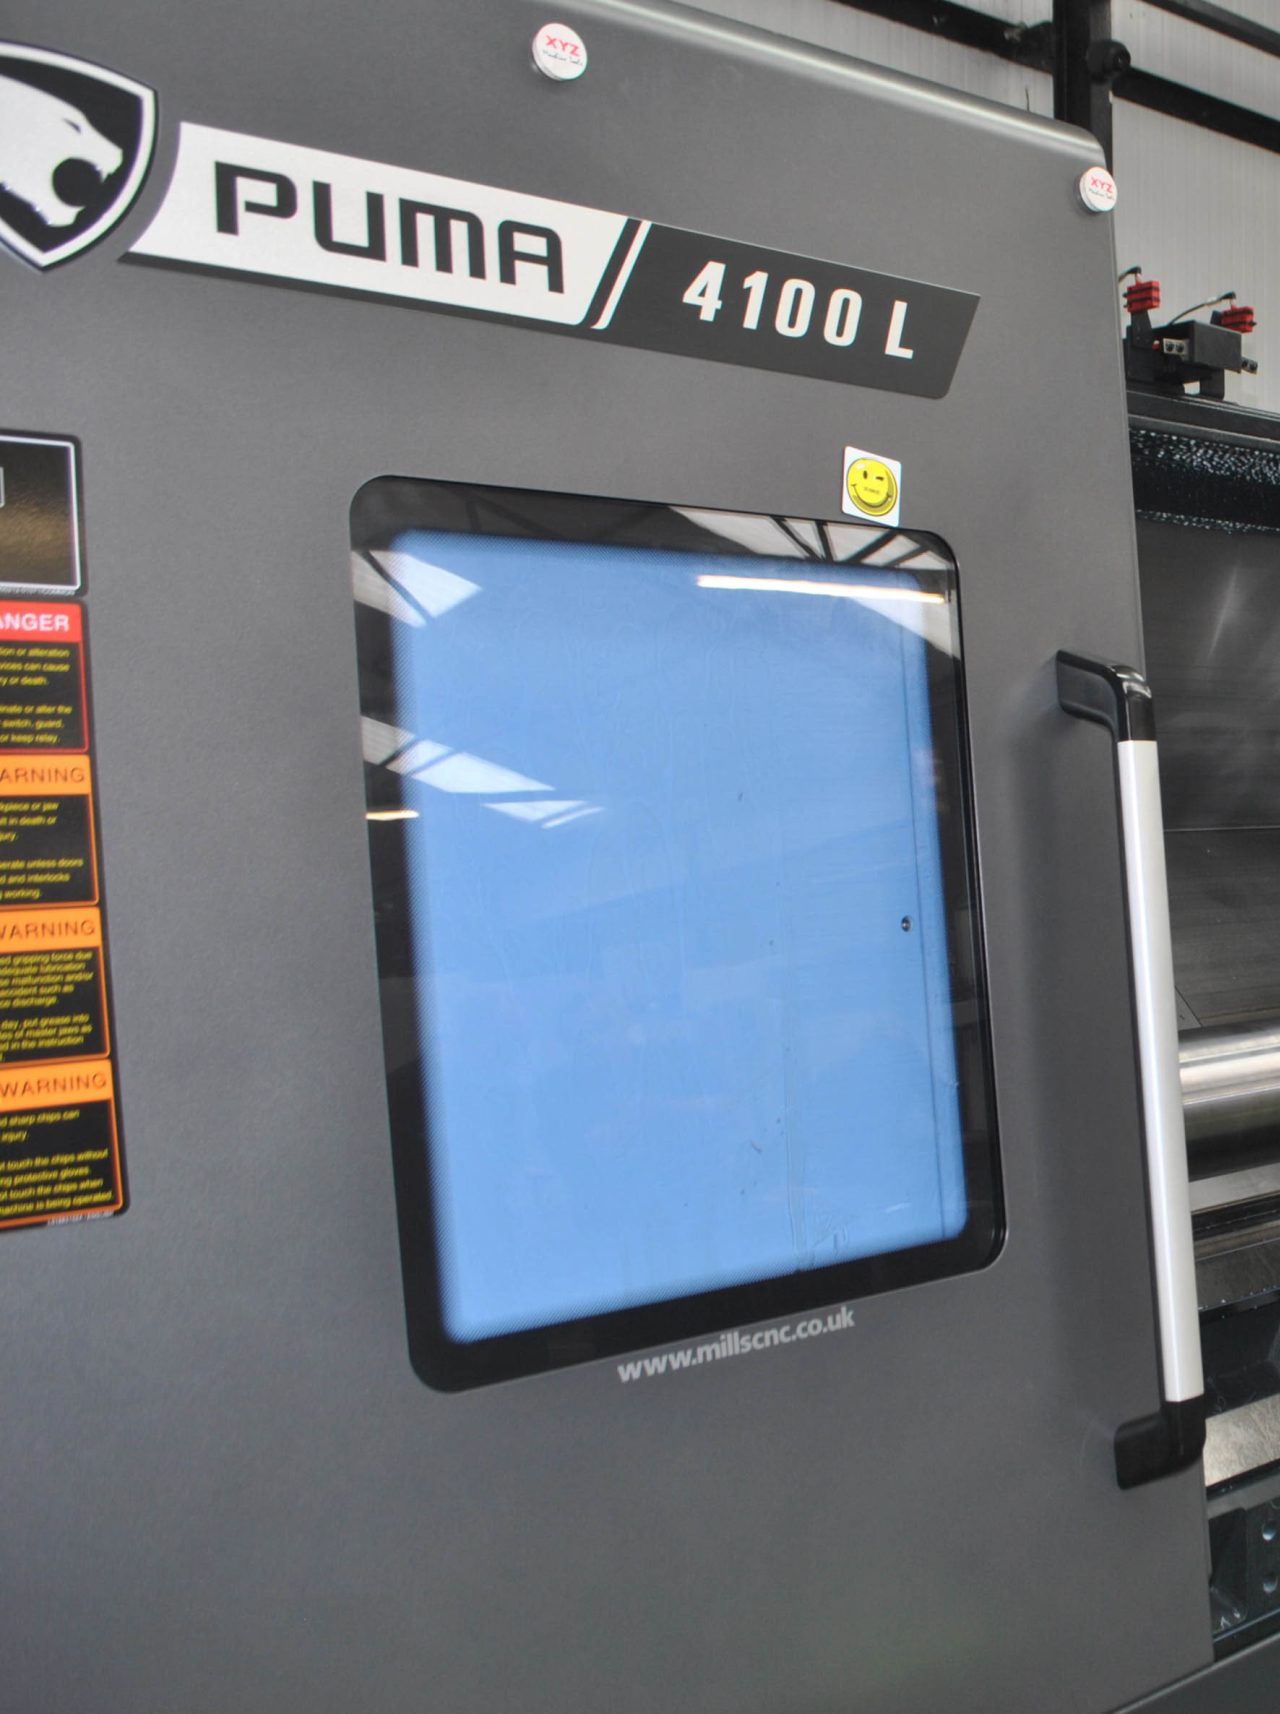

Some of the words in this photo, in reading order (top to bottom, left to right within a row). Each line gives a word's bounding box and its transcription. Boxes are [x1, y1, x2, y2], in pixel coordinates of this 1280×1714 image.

[546, 35, 581, 57] XYZ
[1091, 176, 1113, 193] XYZ
[214, 160, 564, 295] PUMA
[682, 259, 863, 348] 4100
[884, 299, 914, 359] L
[617, 1305, 856, 1383] www.millscnc.co.uk
